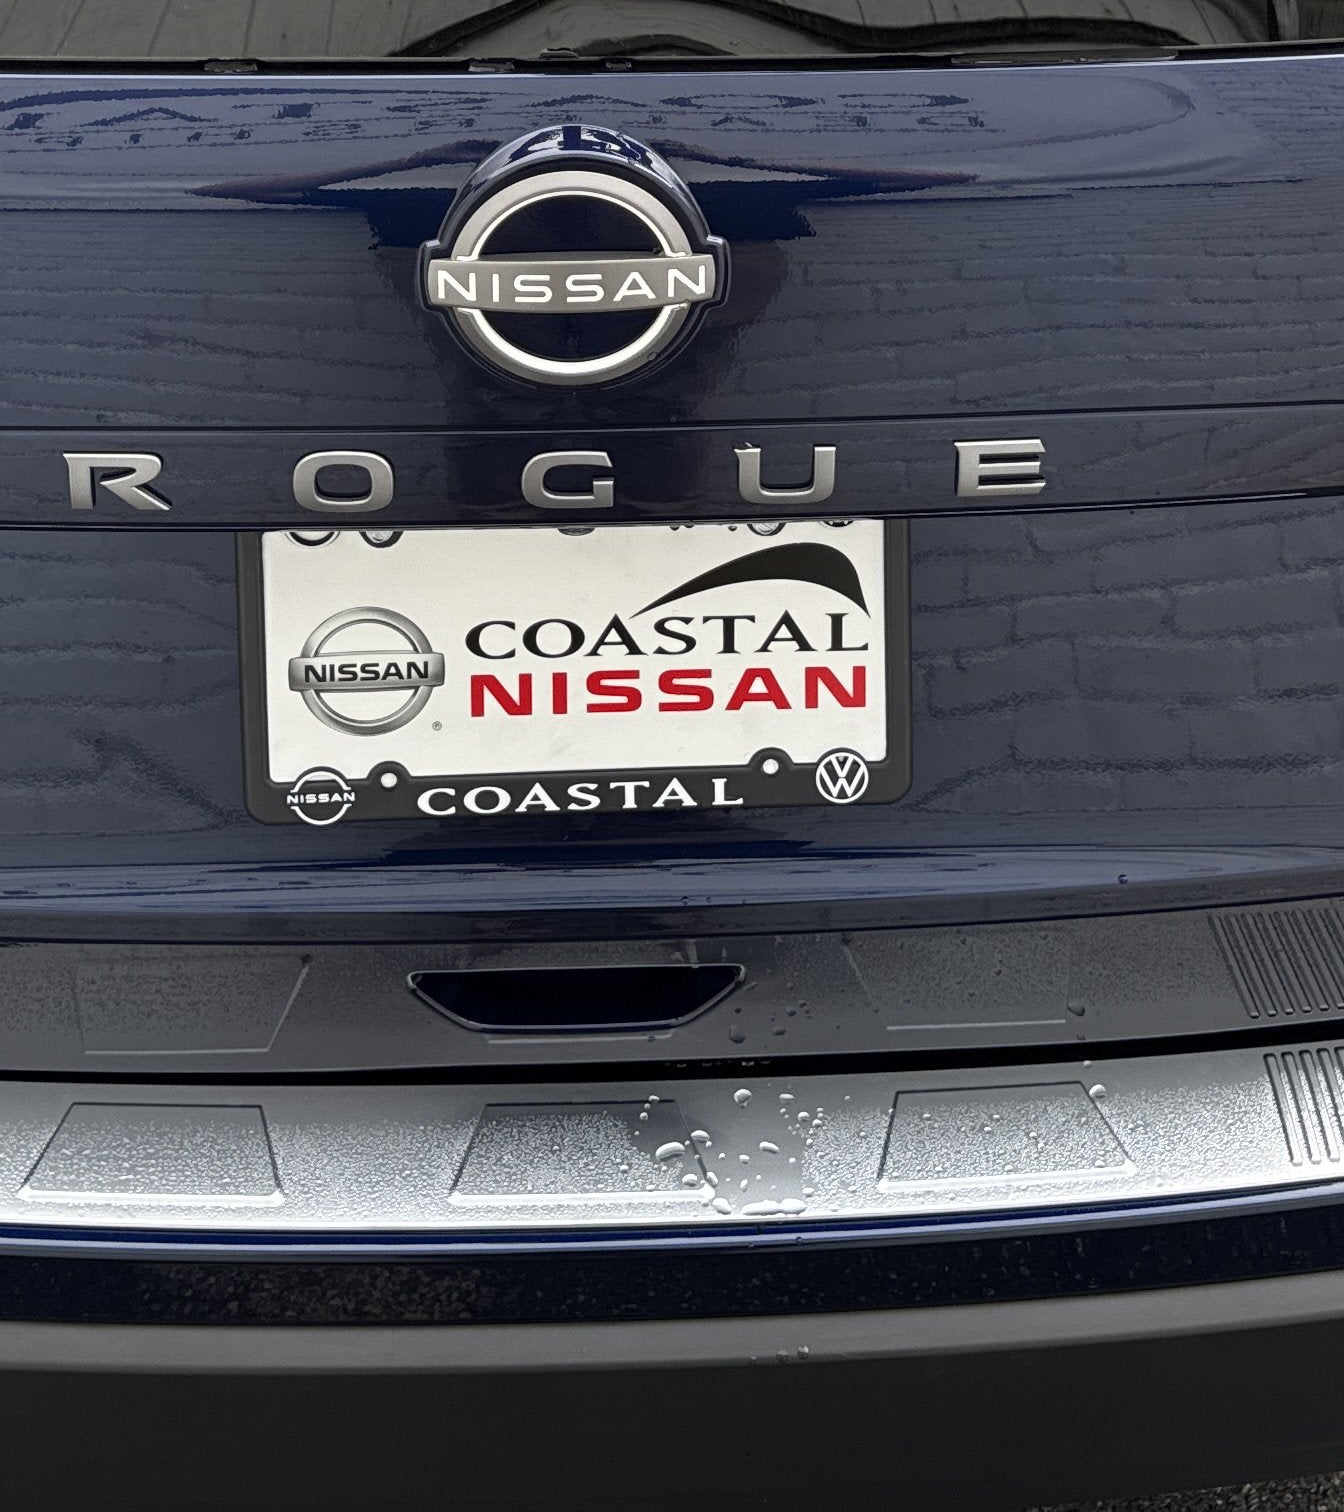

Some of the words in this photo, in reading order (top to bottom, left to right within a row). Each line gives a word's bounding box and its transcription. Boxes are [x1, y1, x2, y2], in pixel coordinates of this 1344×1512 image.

[437, 265, 705, 303] NISSAN
[62, 438, 1048, 513] ROGUE
[464, 609, 869, 660] COASTAL
[304, 661, 429, 683] NISSAN
[470, 665, 867, 718] NISSAN
[286, 792, 355, 805] NISSAN
[417, 777, 744, 816] COASTAL
